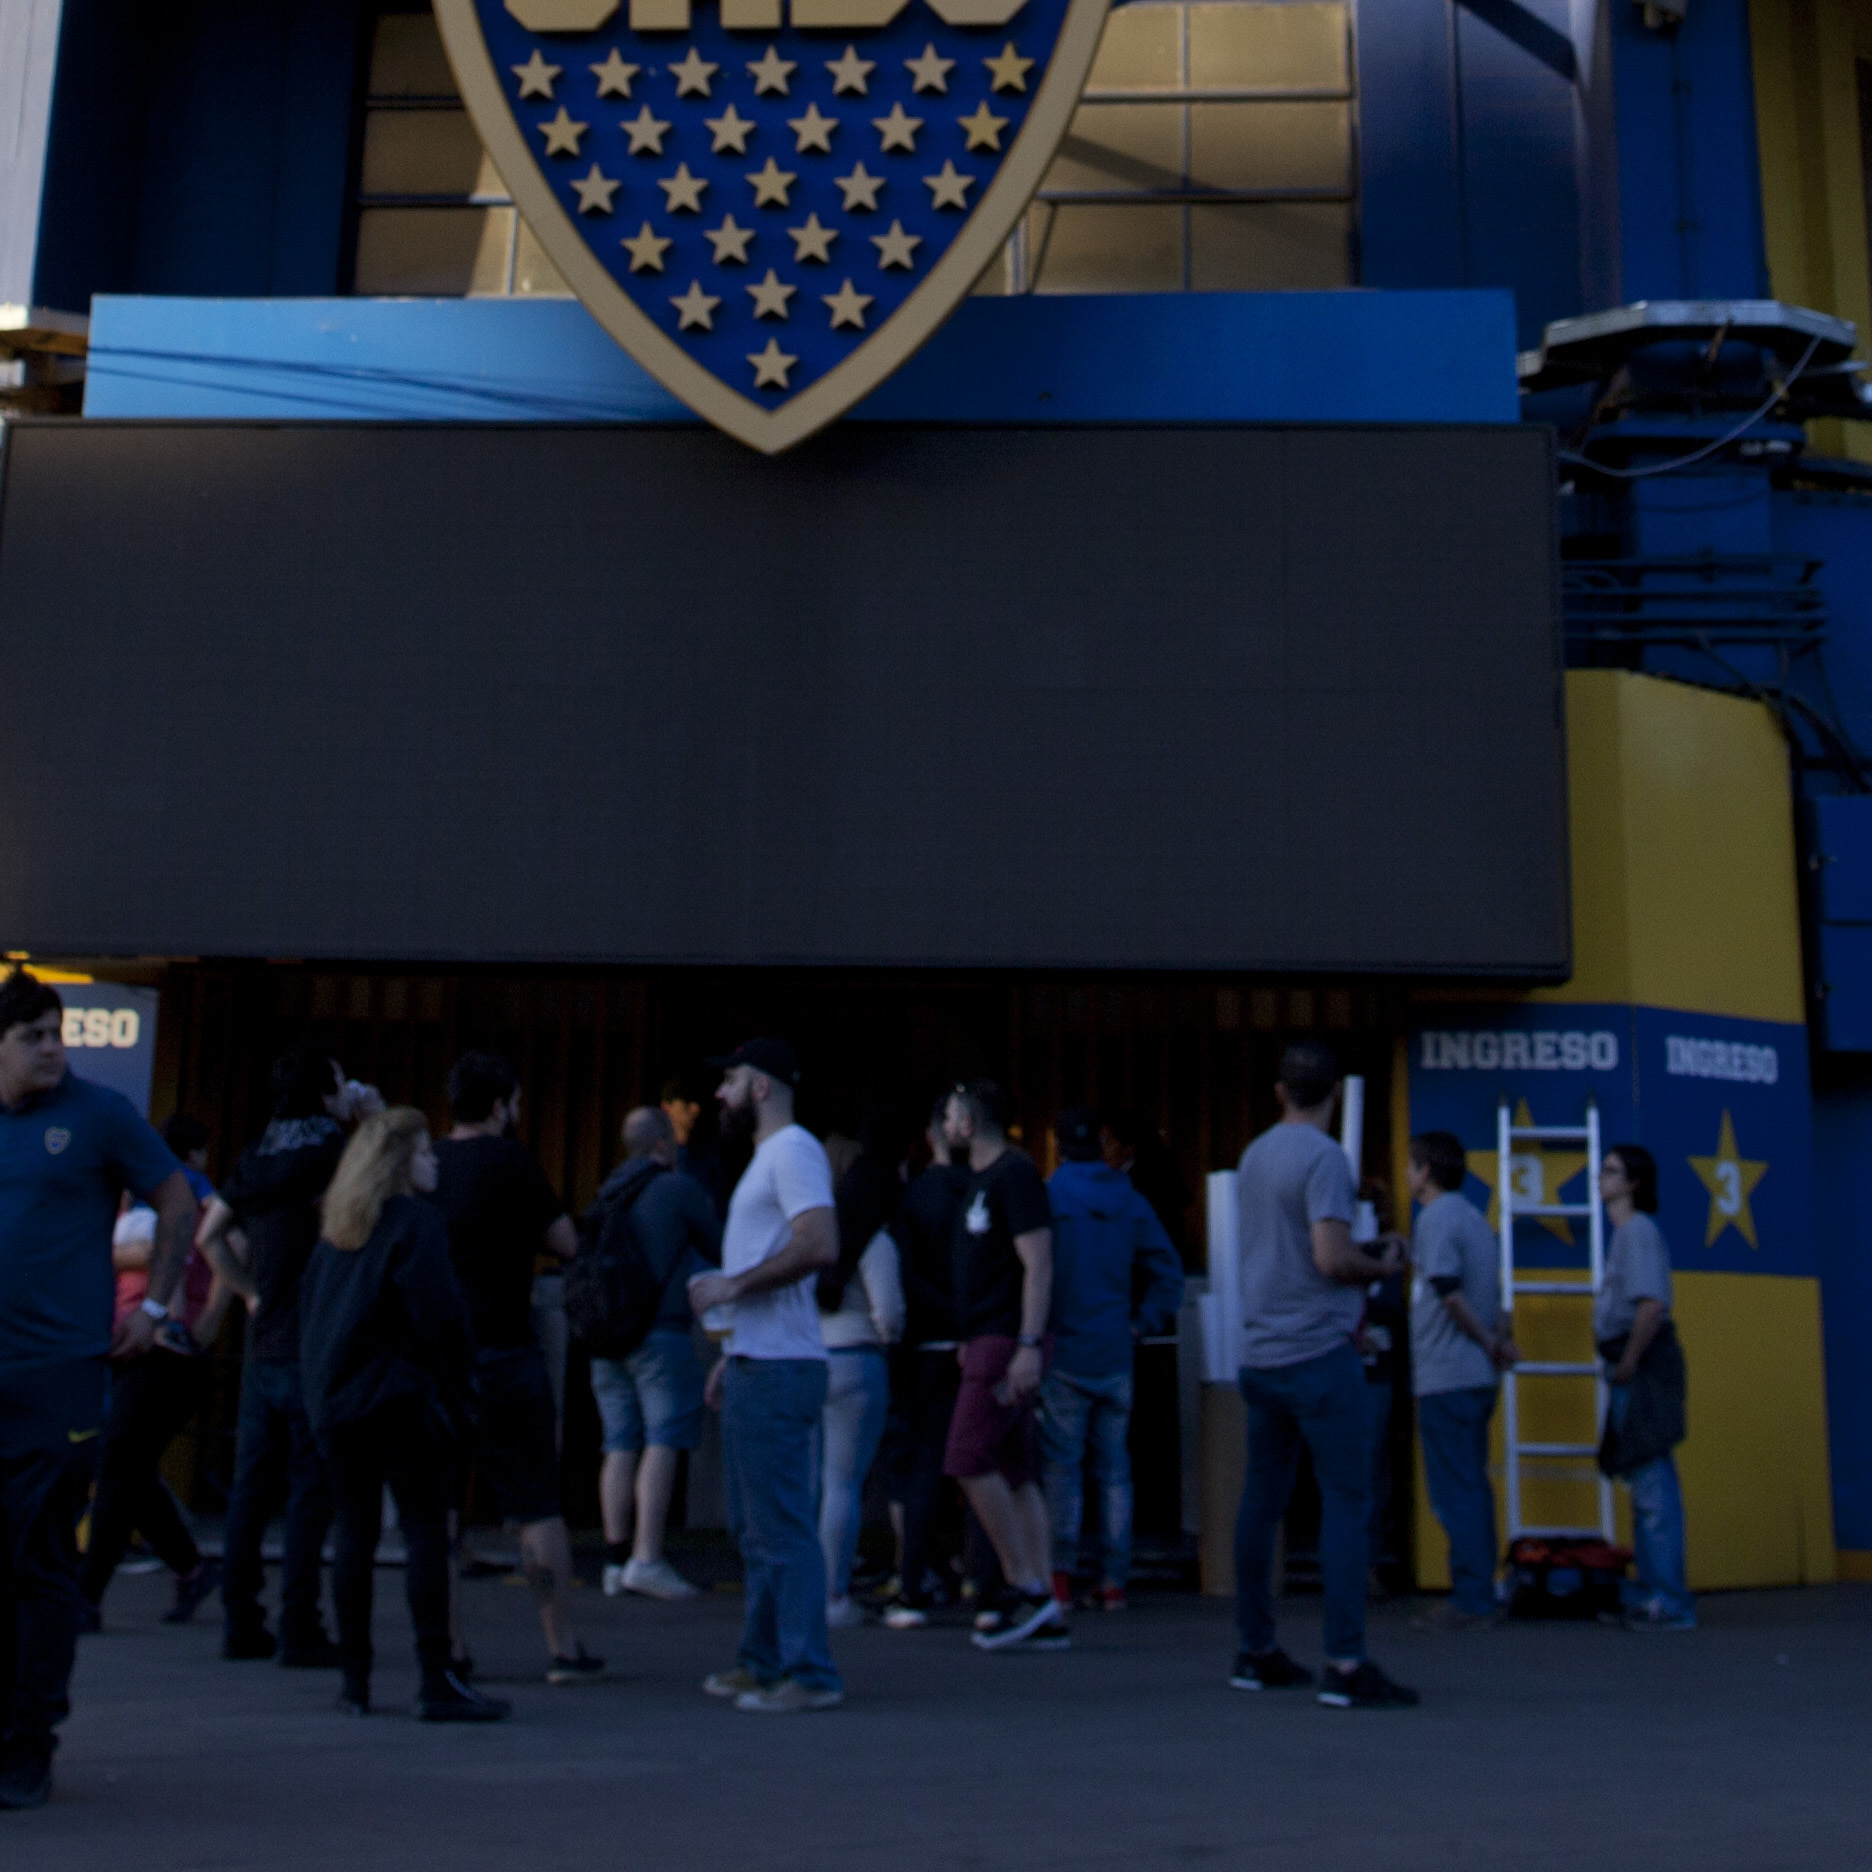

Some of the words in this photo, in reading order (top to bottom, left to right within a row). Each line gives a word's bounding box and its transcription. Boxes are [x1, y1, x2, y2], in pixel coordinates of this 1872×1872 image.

[1420, 1030, 1619, 1071] INGRESO
[1665, 1034, 1779, 1085] INGRESO
[1714, 1160, 1742, 1217] 3
